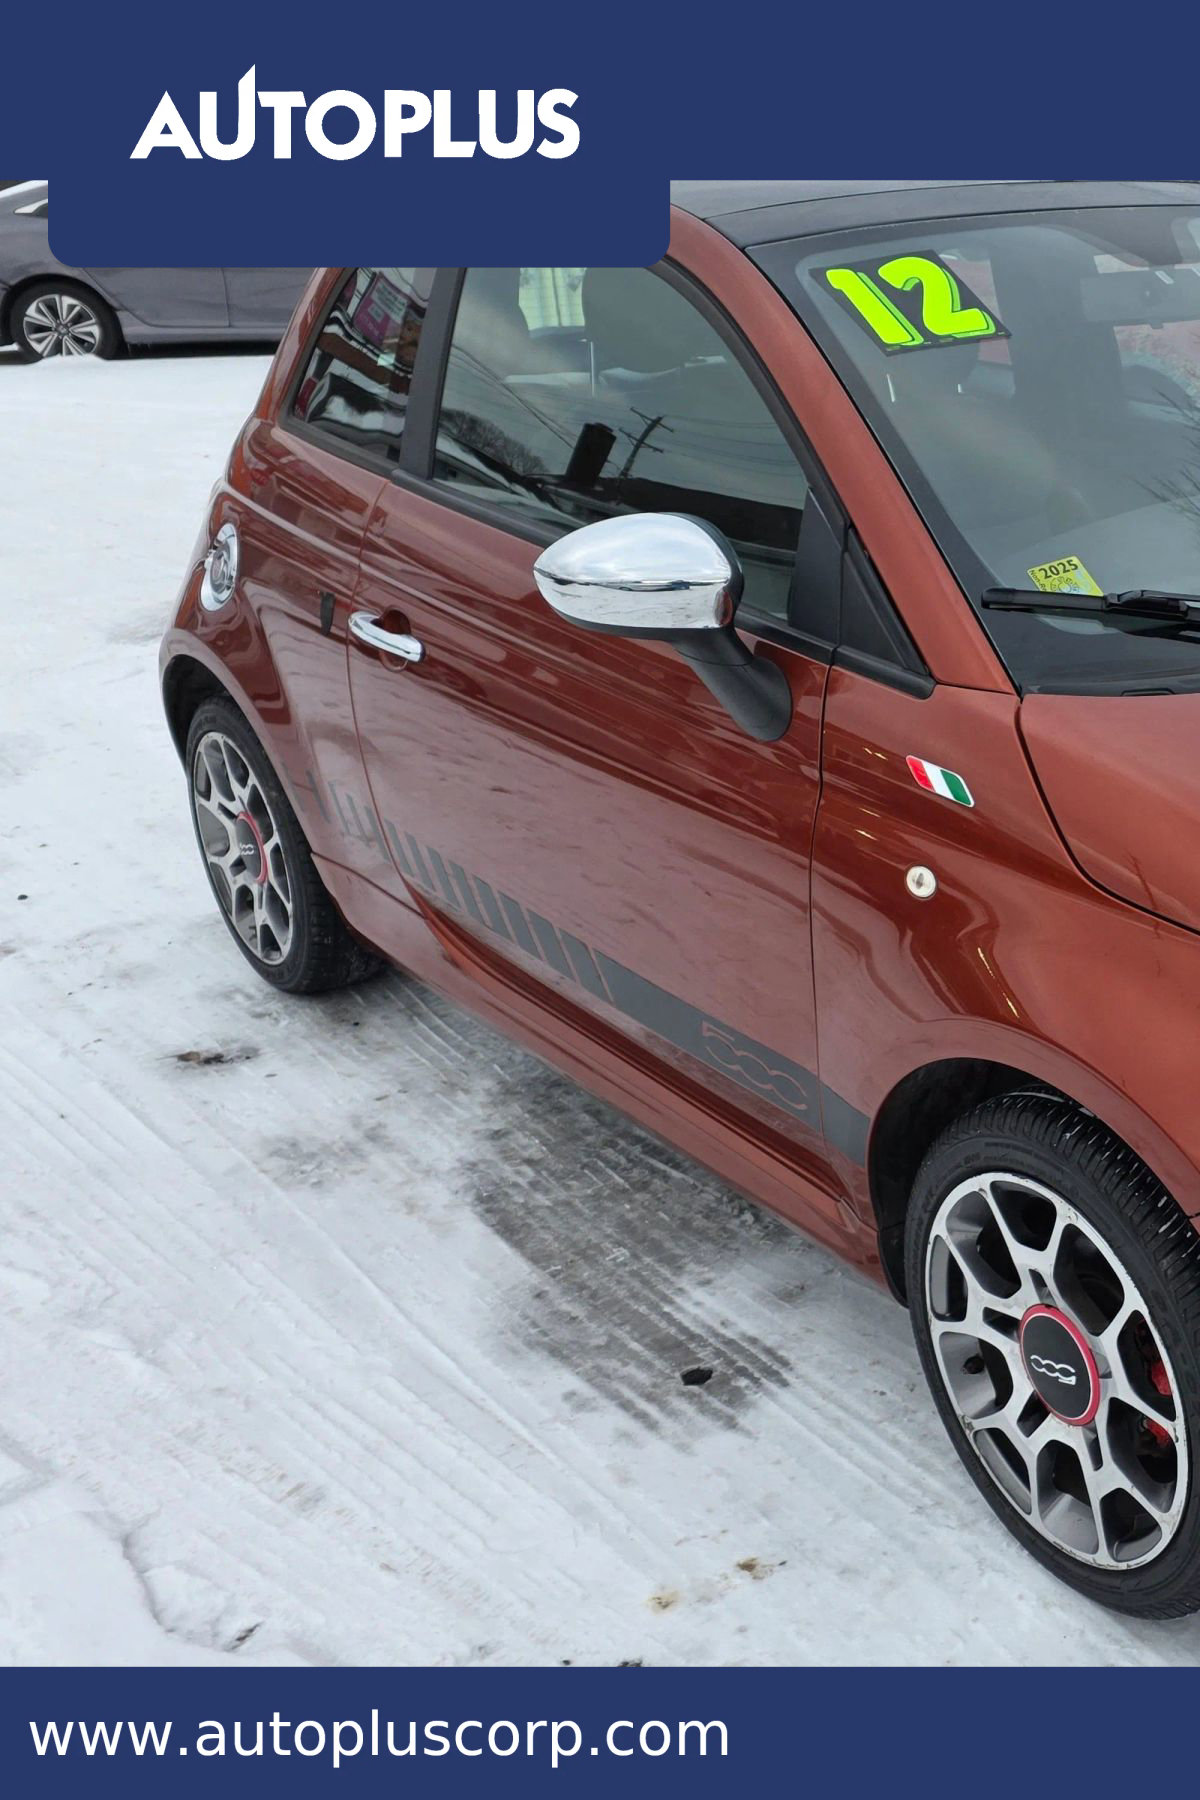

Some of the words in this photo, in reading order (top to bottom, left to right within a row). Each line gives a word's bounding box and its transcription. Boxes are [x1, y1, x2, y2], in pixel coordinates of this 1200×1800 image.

[826, 256, 996, 346] 12
[1038, 559, 1078, 580] 2025
[701, 1020, 808, 1110] 500
[1029, 1354, 1077, 1386] 500
